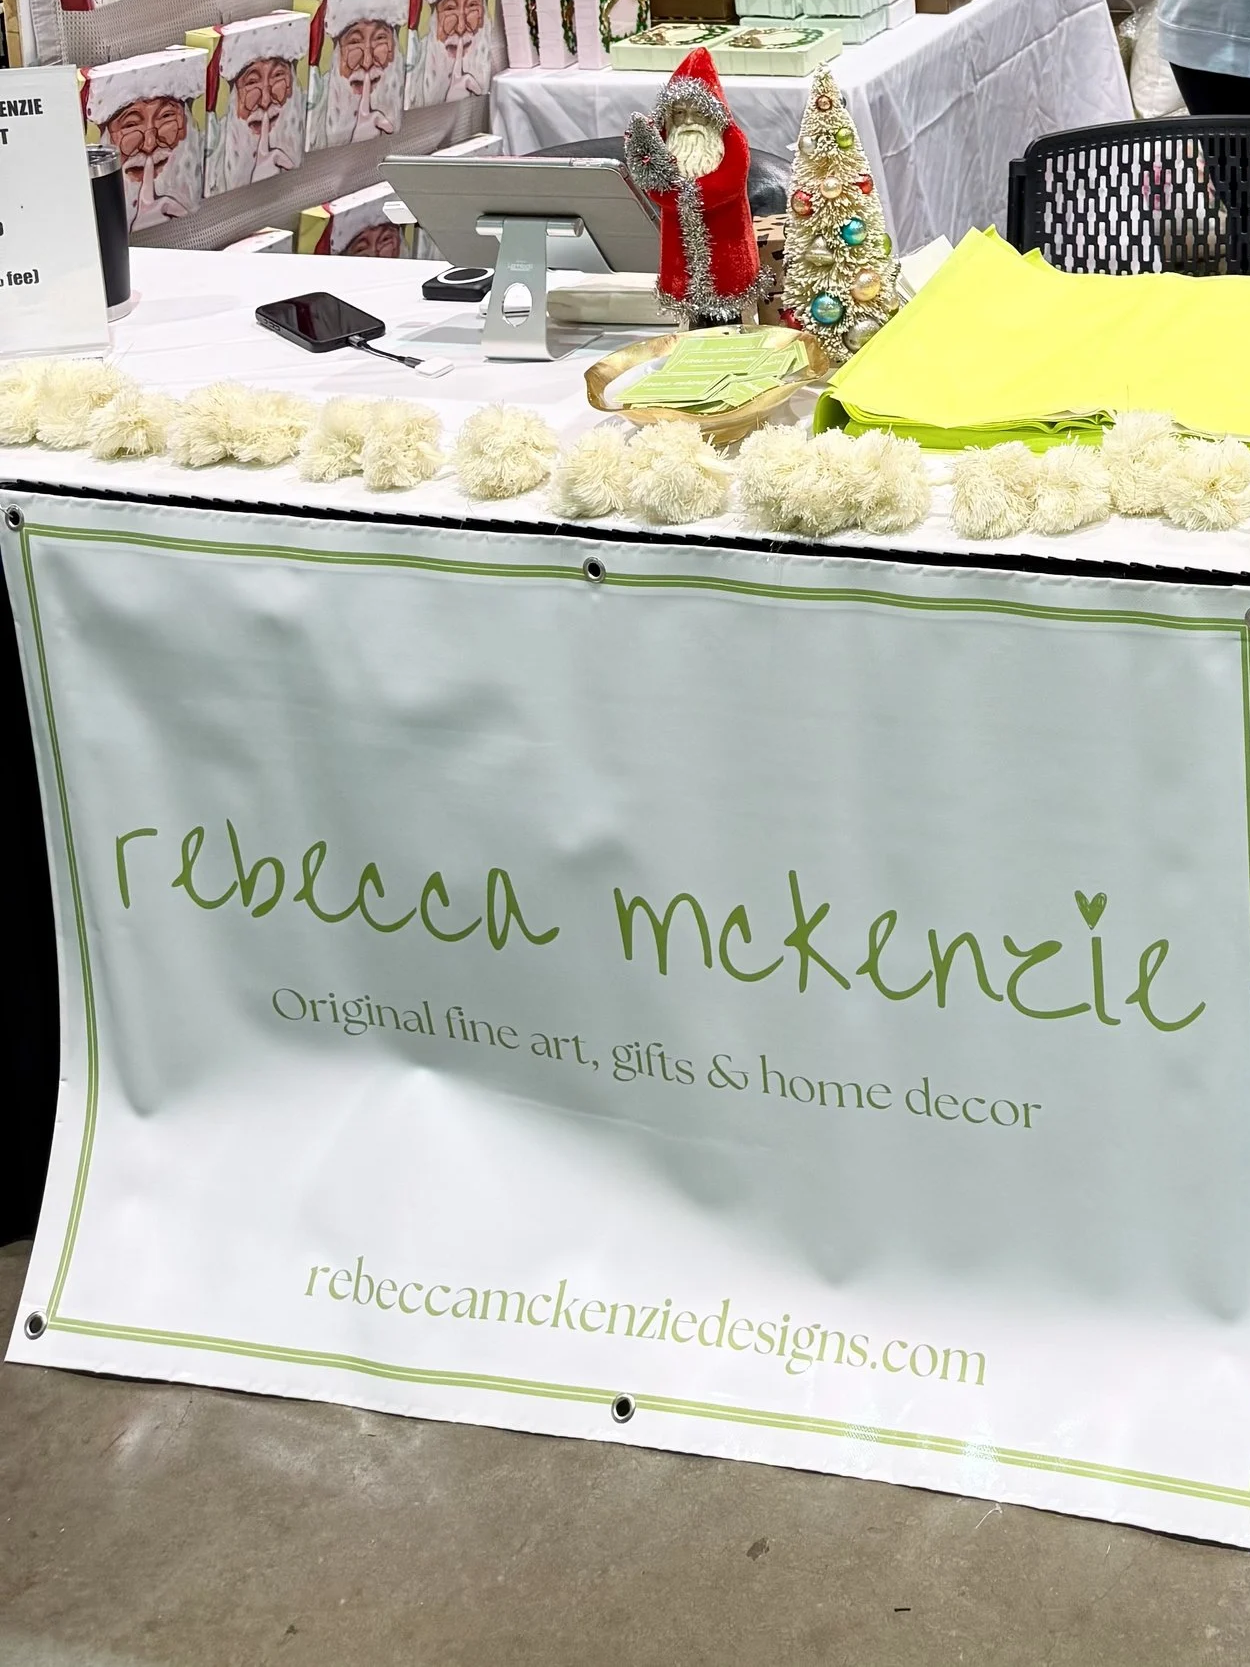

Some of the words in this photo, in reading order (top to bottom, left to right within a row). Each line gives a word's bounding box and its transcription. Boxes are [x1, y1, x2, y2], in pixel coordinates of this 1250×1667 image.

[6, 269, 40, 286] fee)
[115, 818, 560, 951] rebecca
[613, 869, 1206, 1032] mckenzie
[271, 987, 436, 1037] Original
[444, 1005, 519, 1050] fine
[530, 1031, 601, 1072] art,
[611, 1039, 696, 1085] gifts
[706, 1052, 750, 1092] &
[760, 1054, 893, 1110] home
[904, 1077, 1042, 1129] decor
[304, 1255, 988, 1387] rebeccamckenziedesigns.com
